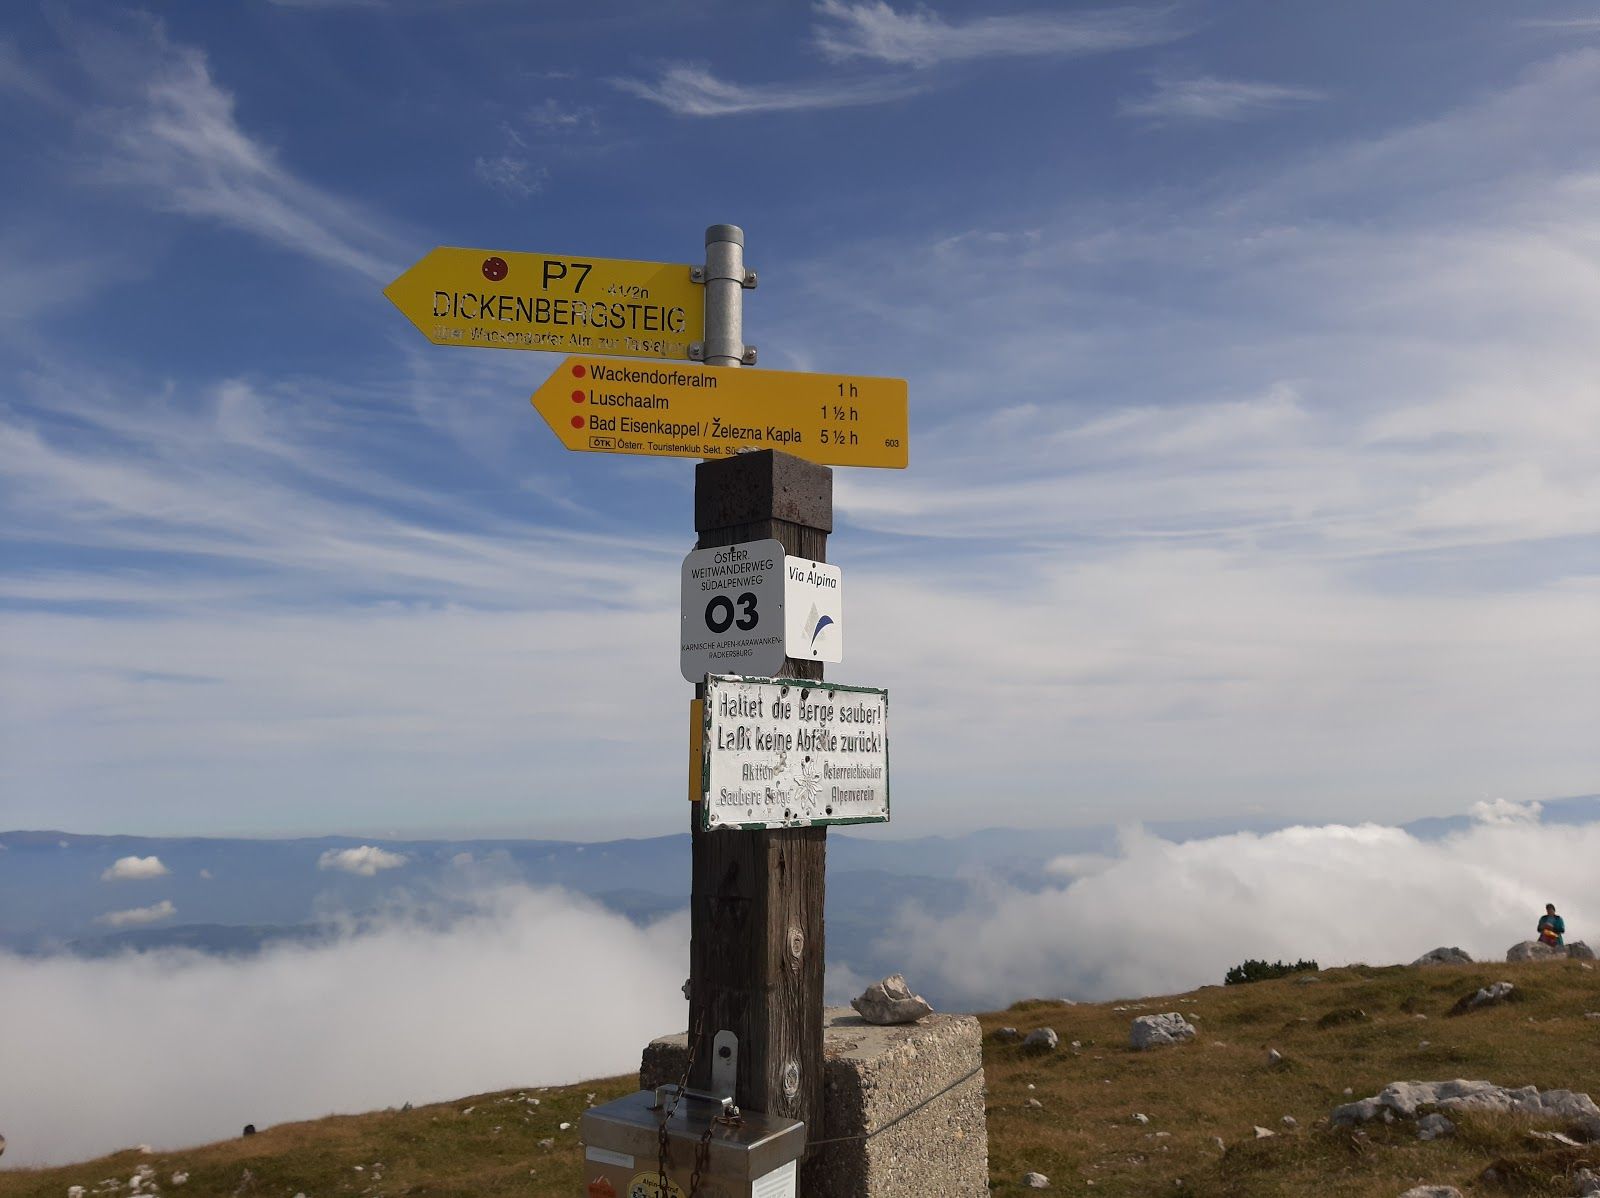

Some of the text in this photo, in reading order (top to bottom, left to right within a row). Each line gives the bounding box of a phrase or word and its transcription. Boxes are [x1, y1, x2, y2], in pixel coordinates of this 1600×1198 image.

[542, 260, 593, 294] P7
[433, 291, 686, 333] DICKENBERGSTEIG
[590, 365, 717, 388] Wackendorferalm
[590, 390, 669, 409] Luschaalm
[838, 383, 858, 397] 1 h
[821, 405, 827, 419] 1
[850, 407, 858, 421] h
[589, 415, 616, 431] Bad
[620, 416, 700, 439] Eisenkappel
[712, 417, 763, 440] Železna
[766, 426, 802, 444] Kapla
[820, 429, 829, 444] 5
[850, 430, 858, 445] h
[593, 438, 611, 447] ÖTK
[617, 438, 645, 450] Österr.
[647, 441, 701, 453] Touristenklub
[703, 445, 723, 455] Sekt.
[884, 439, 900, 448] 603
[691, 559, 774, 579] WEITWANDERWEG
[789, 566, 837, 589] Via Alpina
[701, 575, 763, 591] SÜDALPENWEG
[682, 641, 715, 651] KARNISCHE
[719, 690, 882, 727] Haltet die Berge sauber!
[717, 724, 882, 753] Laßt keine Abfälle zurück!
[831, 786, 875, 807] Alpenverein
